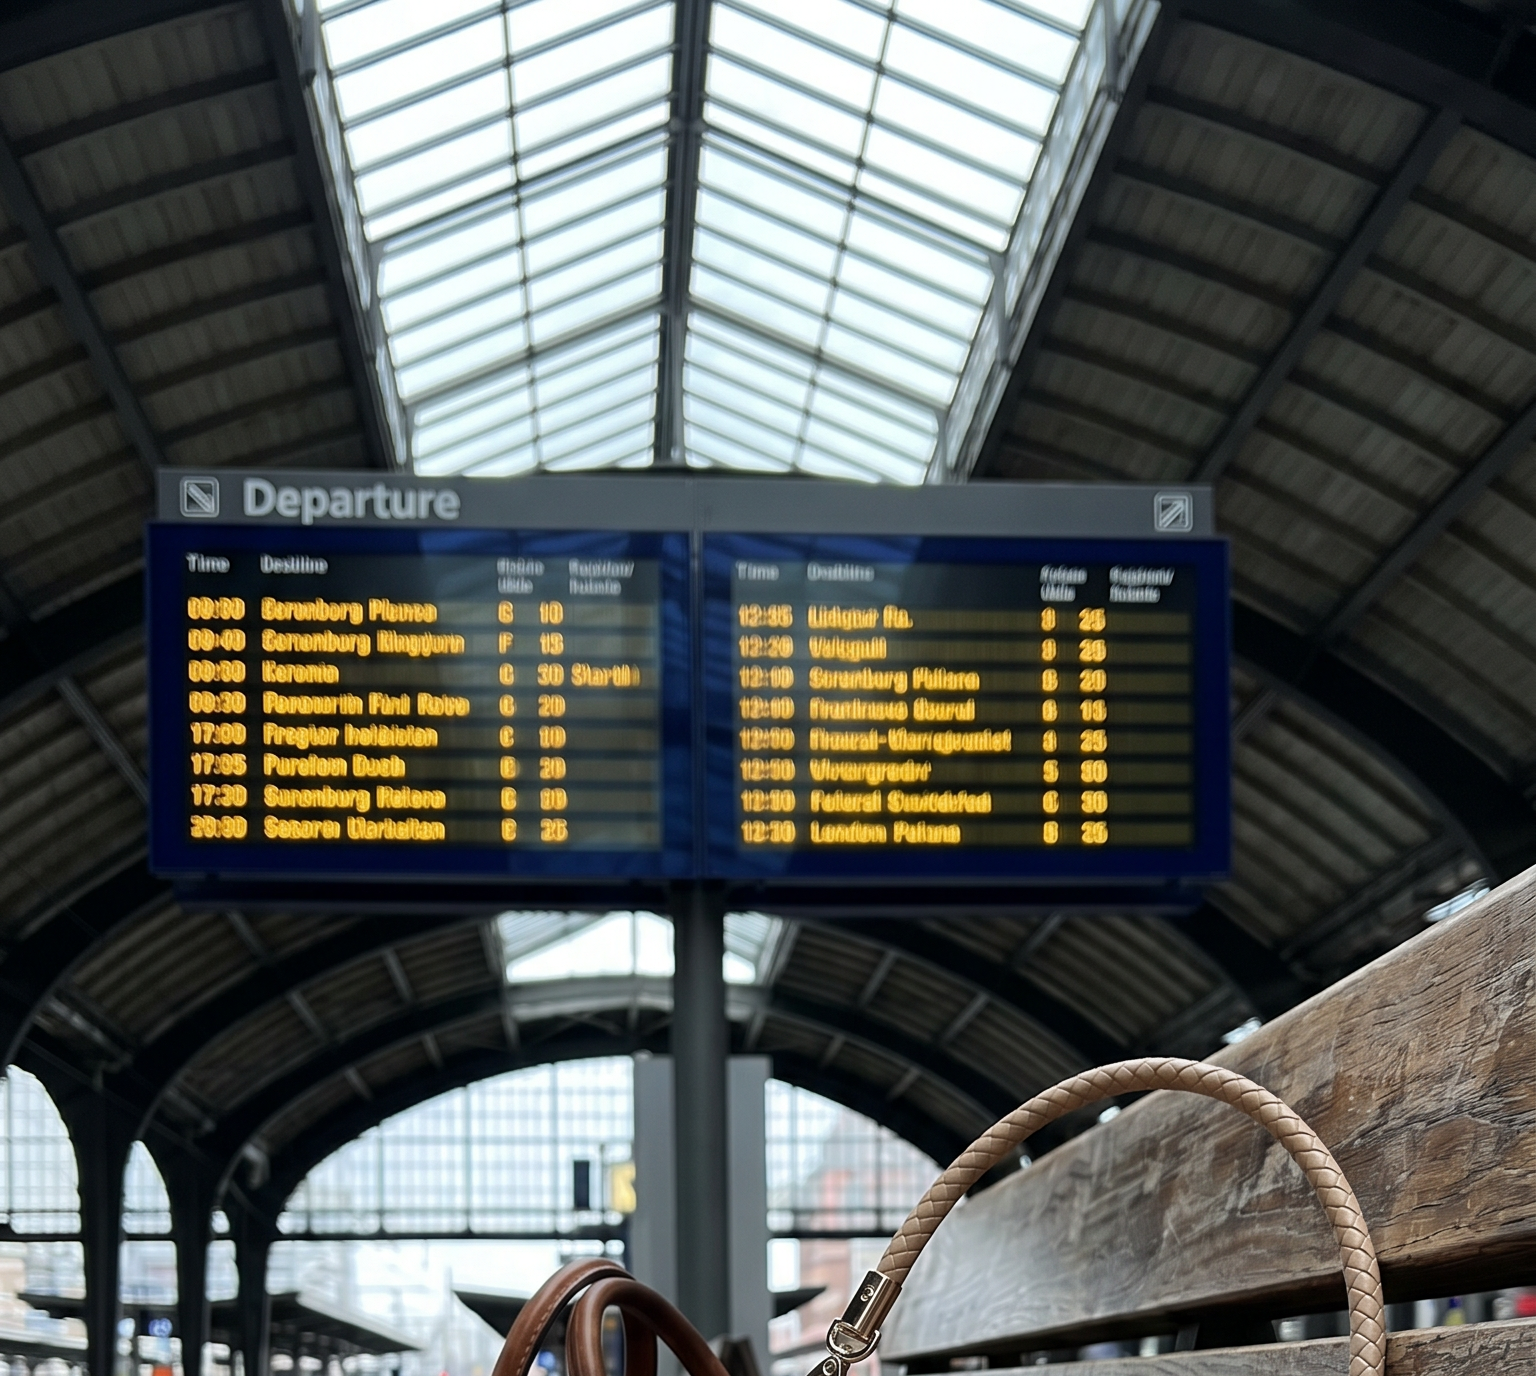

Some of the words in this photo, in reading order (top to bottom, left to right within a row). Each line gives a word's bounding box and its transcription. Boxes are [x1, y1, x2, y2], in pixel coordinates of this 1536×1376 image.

[243, 477, 461, 525] Departure
[1080, 669, 1107, 692] 20
[191, 753, 247, 776] 17:05
[192, 784, 248, 807] 17:30
